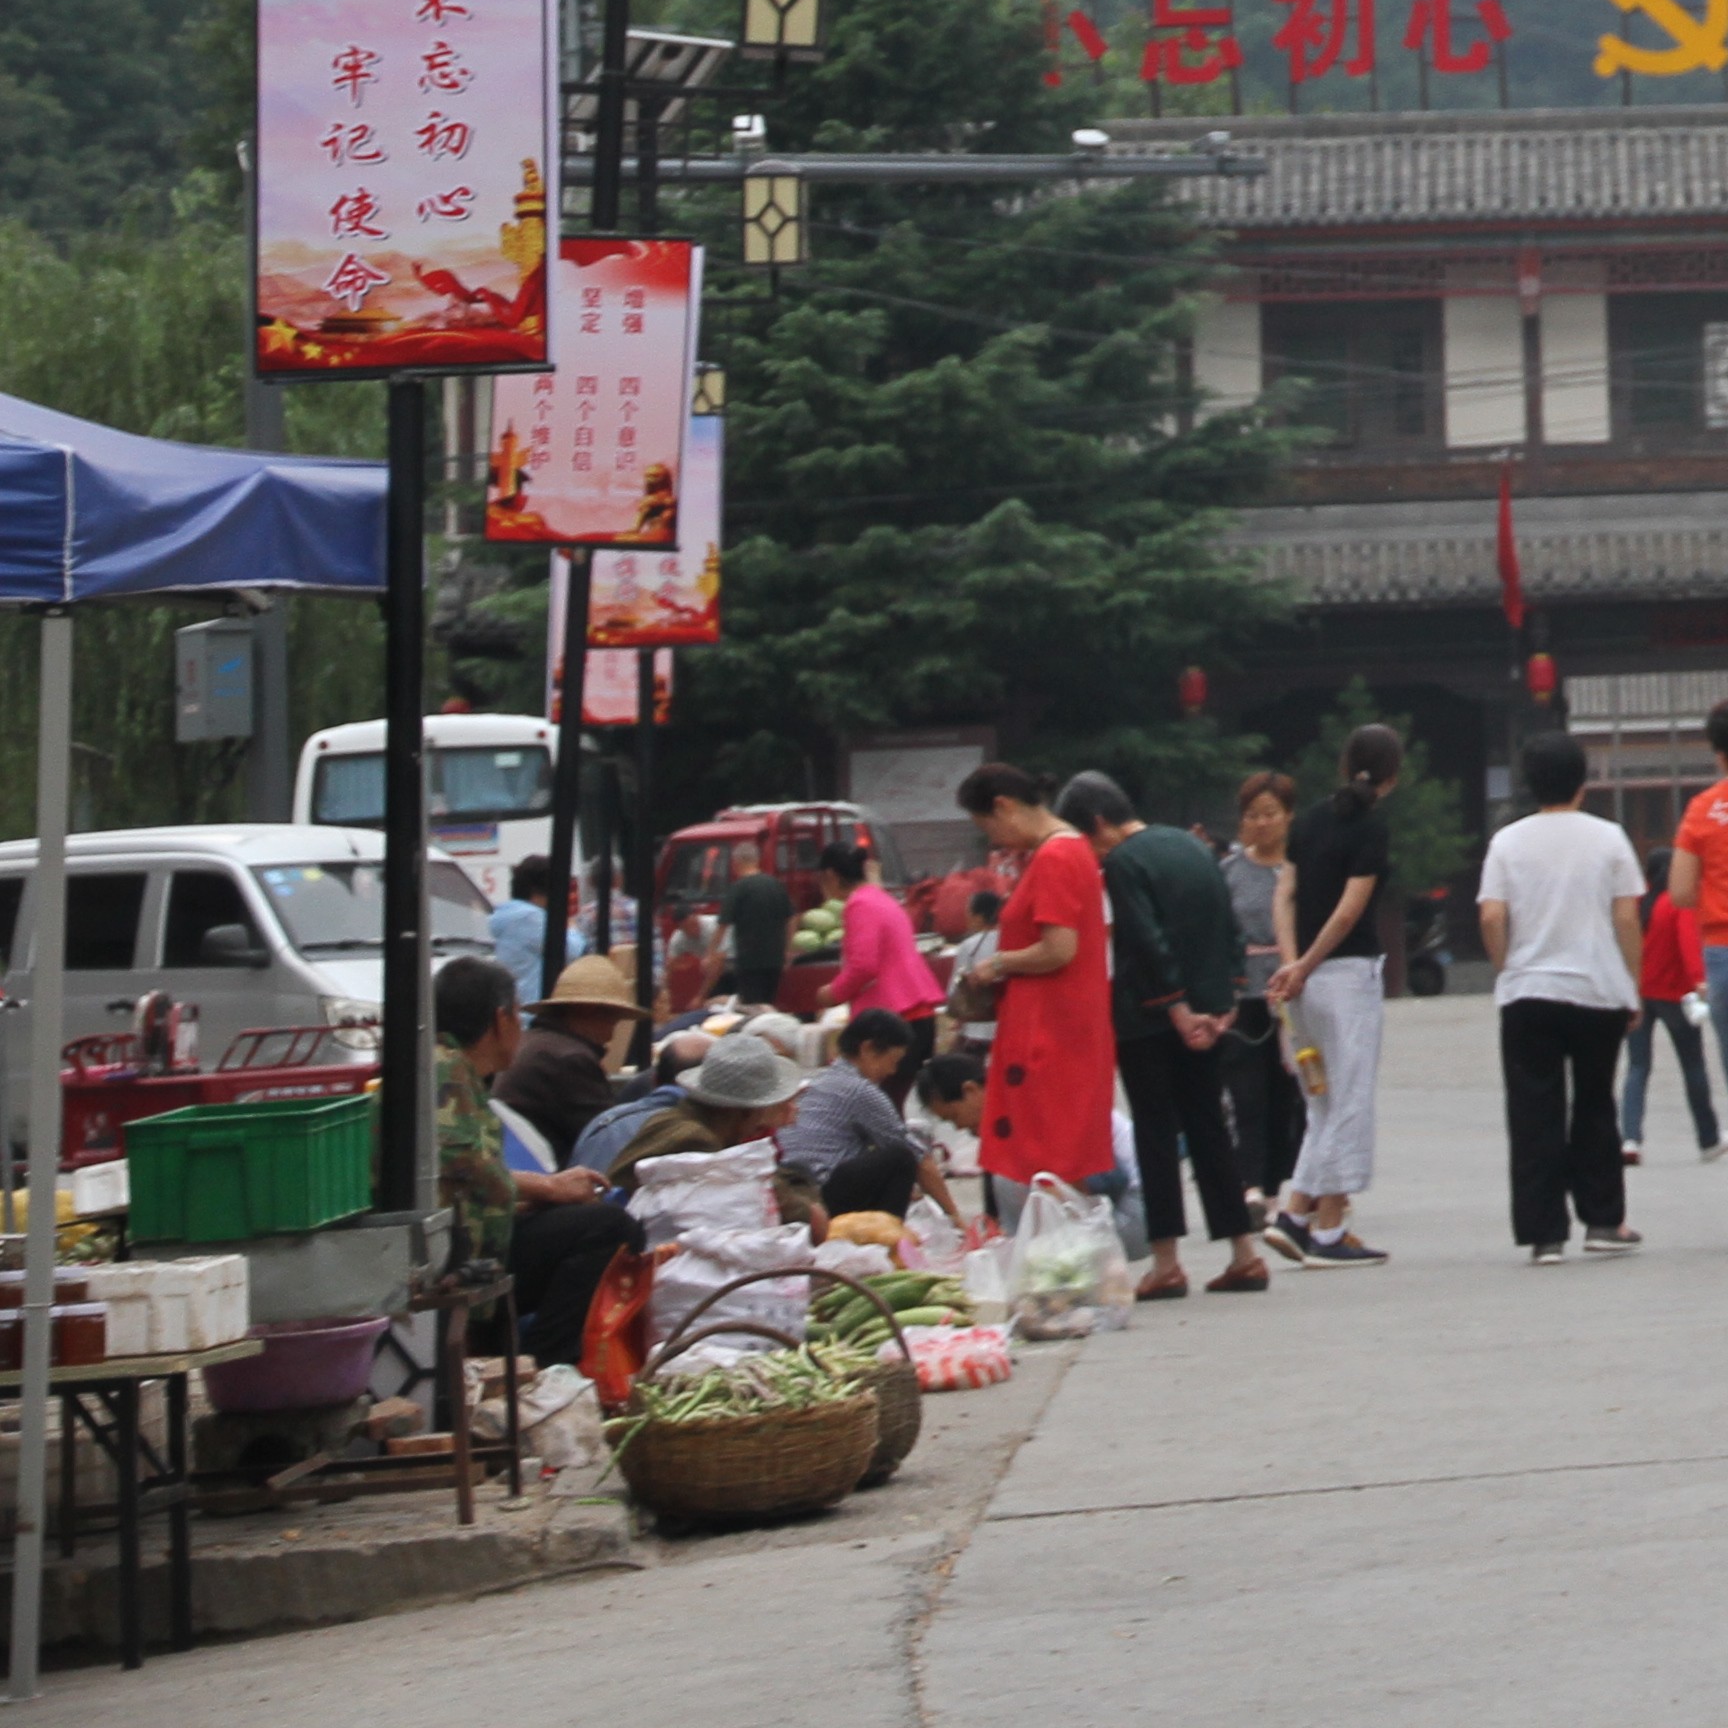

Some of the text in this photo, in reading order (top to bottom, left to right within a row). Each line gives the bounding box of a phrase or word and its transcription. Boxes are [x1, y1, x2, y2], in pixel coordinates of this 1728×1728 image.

[319, 45, 392, 310] 牢记使命
[573, 376, 597, 471] 四个自信
